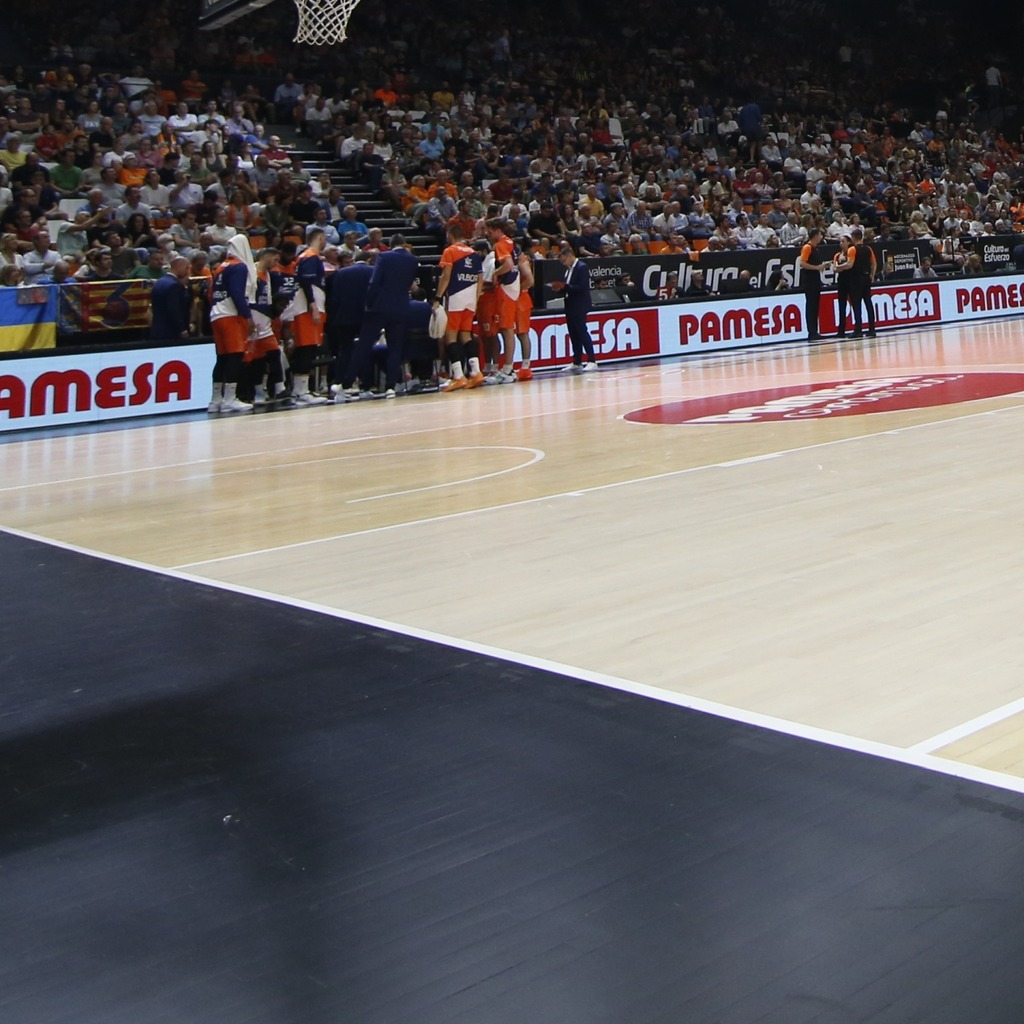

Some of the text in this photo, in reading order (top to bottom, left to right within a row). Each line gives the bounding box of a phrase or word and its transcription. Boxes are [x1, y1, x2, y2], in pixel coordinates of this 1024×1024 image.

[984, 244, 1005, 253] Cultura
[984, 253, 1010, 263] Esfuerzo
[589, 265, 621, 277] valencia
[679, 304, 802, 345] PAMESA
[0, 360, 192, 419] AMESA
